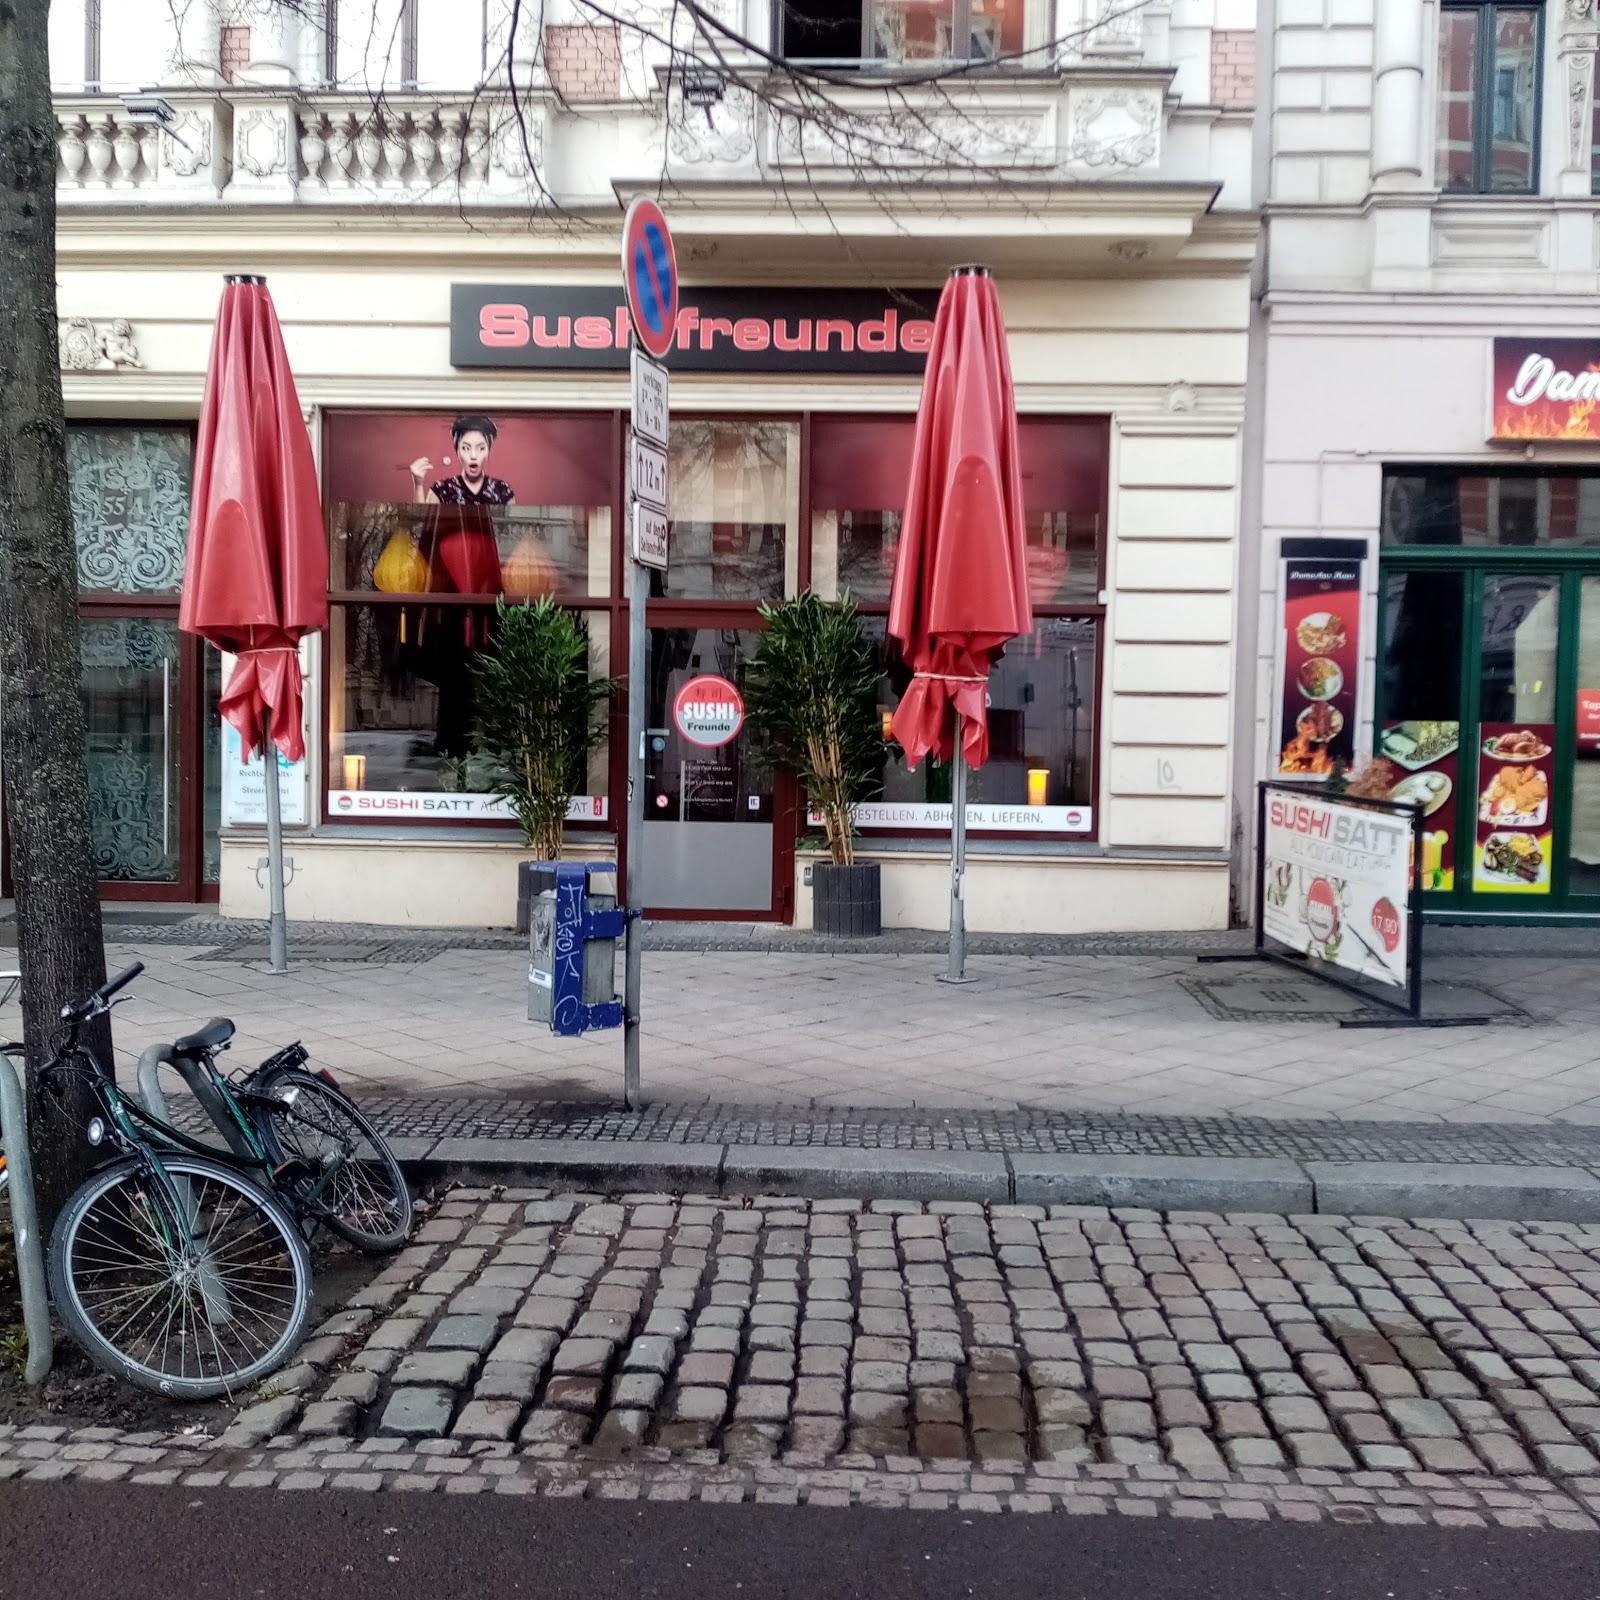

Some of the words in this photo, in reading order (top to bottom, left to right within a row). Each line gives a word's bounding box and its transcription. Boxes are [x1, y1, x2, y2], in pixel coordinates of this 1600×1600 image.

[645, 458, 653, 489] 12
[683, 701, 735, 720] SUSHI
[687, 721, 731, 732] Freunde
[358, 797, 419, 810] SUSHI
[422, 799, 475, 811] SATT
[991, 811, 1044, 824] LIEFERN.
[1271, 801, 1332, 839] SUSHI
[1333, 815, 1404, 856] SATT
